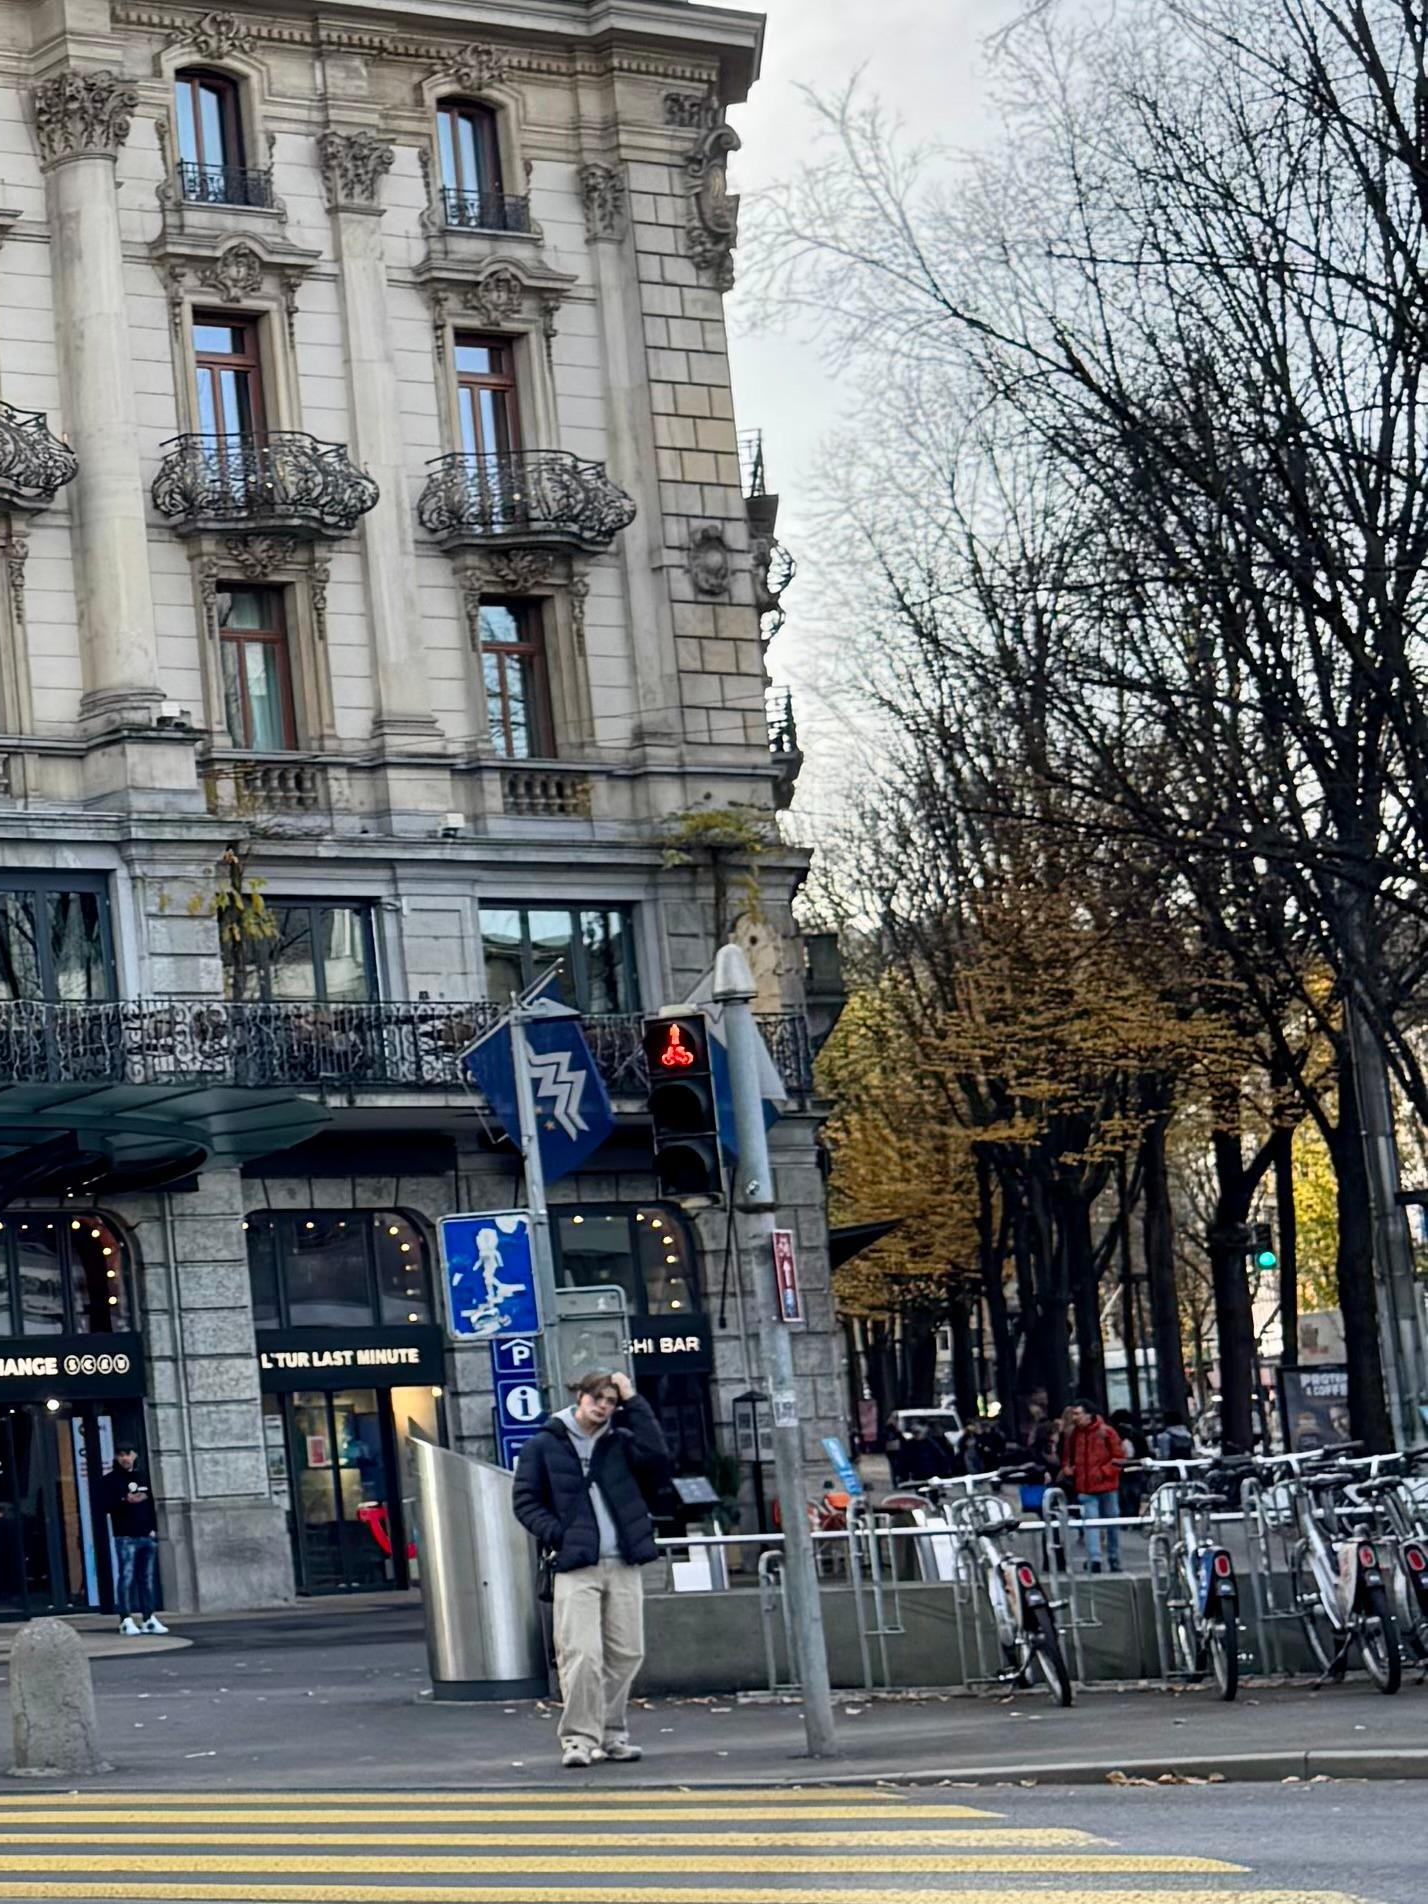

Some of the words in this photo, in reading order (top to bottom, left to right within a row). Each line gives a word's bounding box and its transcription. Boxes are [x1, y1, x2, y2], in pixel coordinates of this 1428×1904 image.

[660, 1336, 700, 1353] BAR
[312, 1350, 354, 1367] LAST
[357, 1348, 420, 1365] MINUTE
